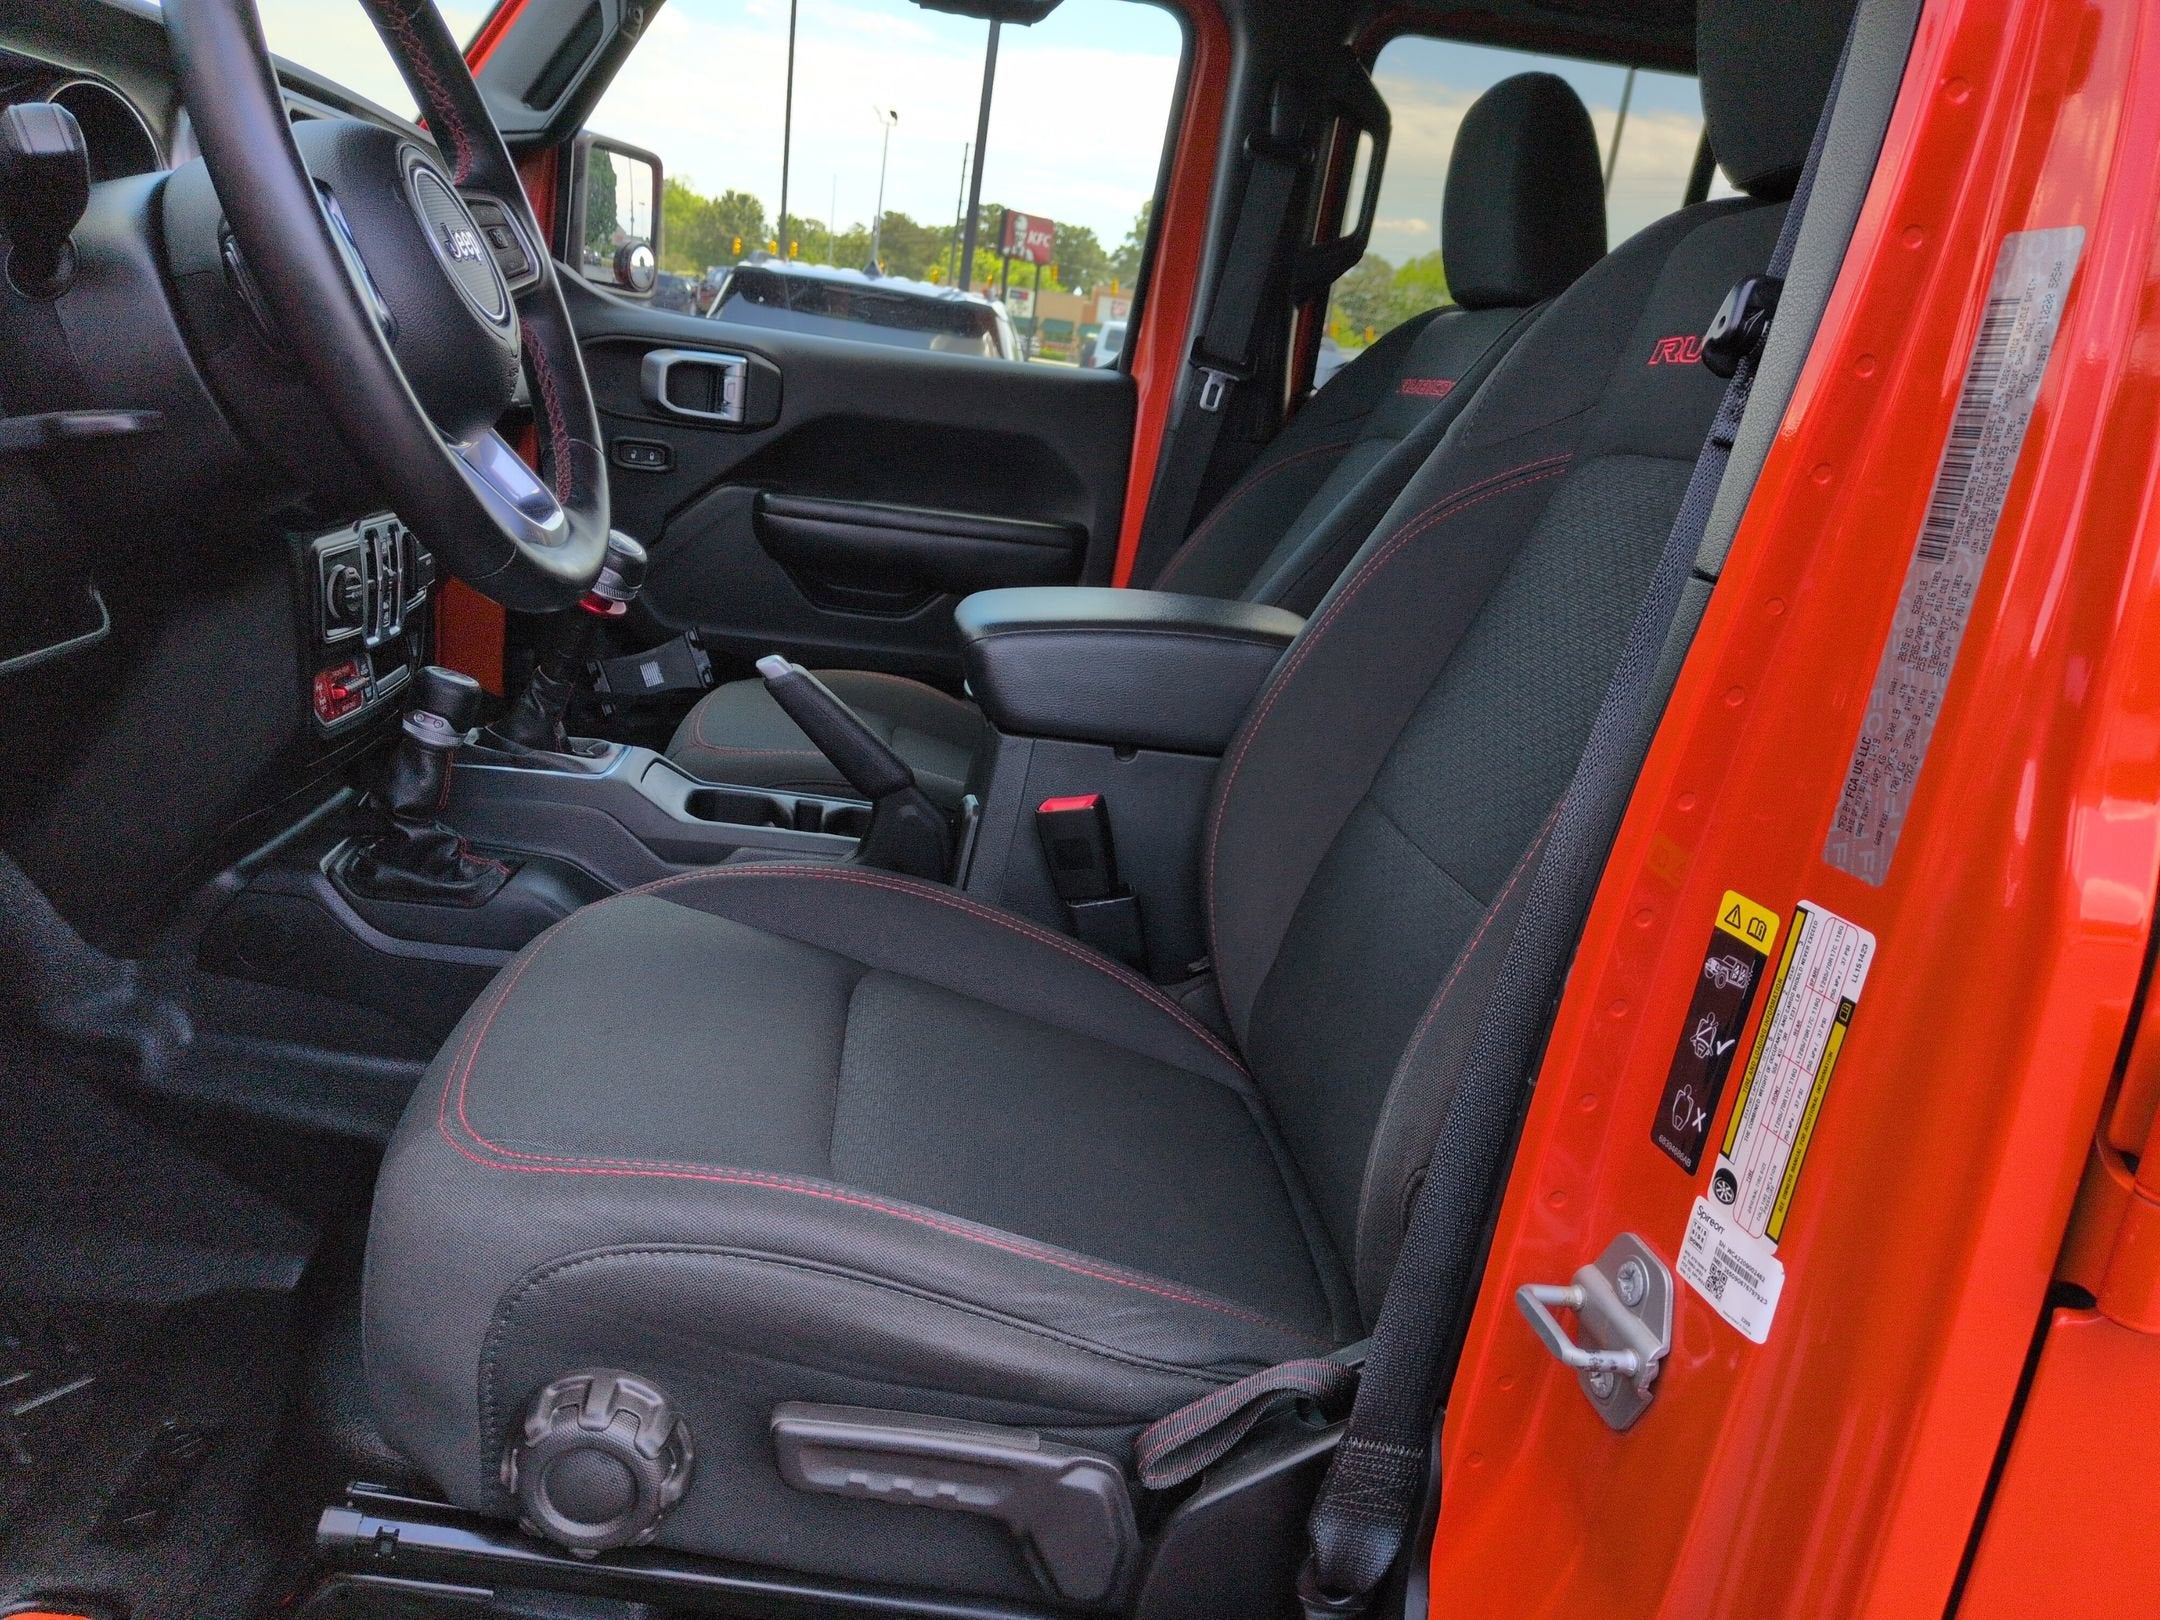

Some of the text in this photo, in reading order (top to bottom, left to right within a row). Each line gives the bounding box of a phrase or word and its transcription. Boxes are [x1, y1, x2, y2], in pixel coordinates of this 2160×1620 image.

[441, 222, 482, 262] Jeep
[1027, 230, 1052, 248] KFC
[1974, 445, 2010, 532] 1C6JJTBG3LL151423
[2014, 372, 2032, 398] TRUCK
[1960, 509, 1978, 545] STANDARDS
[1975, 472, 1990, 496] EFFECT
[1950, 520, 1966, 547] VEHICLE
[1977, 527, 1994, 555] VEHICLE
[1945, 549, 1957, 565] THIS
[1917, 579, 1929, 590] LB
[1910, 594, 1924, 614] 6250
[1944, 595, 1957, 611] 116
[1903, 626, 1915, 639] KG
[1896, 640, 1911, 662] 2835
[1870, 766, 1883, 788] 1407
[1877, 753, 1887, 765] KG
[1883, 721, 1897, 742] 3100
[1890, 707, 1901, 720] LB
[1923, 591, 1937, 607] 116
[1883, 746, 1899, 777] 17X7.5
[1914, 655, 1928, 672] 255
[1927, 615, 1940, 627] 37
[1902, 753, 1919, 784] 17X7.5
[1935, 660, 1948, 678] 255
[1948, 619, 1961, 632] 37
[1909, 713, 1921, 725] LB
[1857, 735, 1871, 757] LLC
[1867, 737, 1881, 762] 11-19
[1902, 727, 1917, 749] 3750
[1851, 757, 1865, 775] US
[1895, 759, 1907, 772] KG
[1844, 775, 1859, 799] FCA
[1889, 774, 1902, 795] 1701
[1841, 800, 1852, 812] BY
[1850, 942, 1869, 983] LL151423
[1742, 976, 1783, 1094] TIRE AND LOADING INFORMATION
[1747, 1097, 1761, 1130] COMBINED
[1757, 1073, 1768, 1098] WEIGHT
[1768, 1027, 1783, 1065] OCCUPANTS
[1780, 1013, 1788, 1027] AND
[1784, 991, 1795, 1013] CARGO
[1791, 965, 1803, 992] SHOULD
[1799, 943, 1810, 966] NEVER
[1806, 918, 1818, 944] EXCEED
[1770, 1084, 1780, 1106] FRONT
[1792, 1018, 1802, 1037] REAR
[1808, 966, 1819, 987] SPARE
[1772, 1085, 1792, 1134] LT285/70R17C
[1795, 1015, 1815, 1064] LT285/70R17C
[1817, 943, 1838, 993] LT285/70R17C
[1789, 1146, 1802, 1174] MANUAL
[1803, 1095, 1819, 1133] ADDITIONAL
[1815, 1049, 1834, 1095] INFORMATION
[1692, 1220, 1707, 1237] THIS
[1695, 1203, 1725, 1235] Spireon
[1689, 1235, 1702, 1251] DOWN
[1691, 1228, 1704, 1243] SIDE
